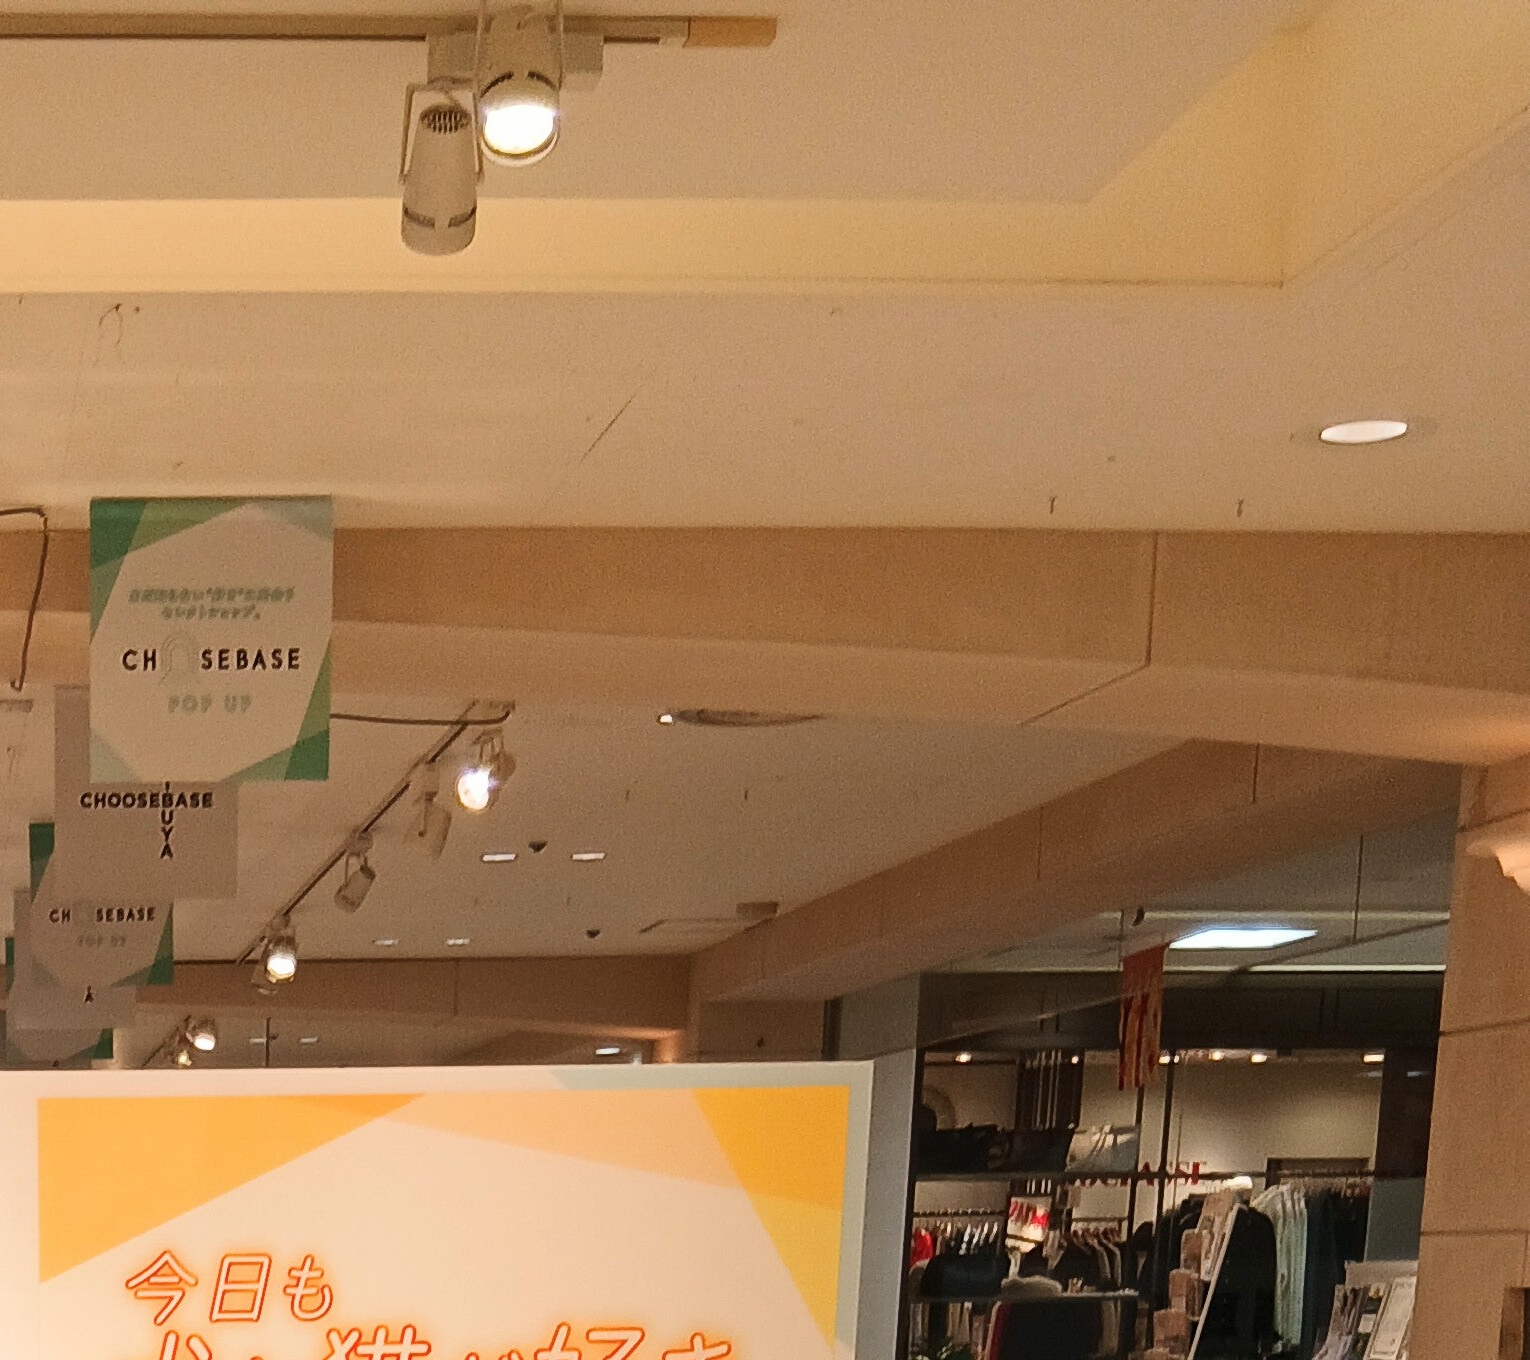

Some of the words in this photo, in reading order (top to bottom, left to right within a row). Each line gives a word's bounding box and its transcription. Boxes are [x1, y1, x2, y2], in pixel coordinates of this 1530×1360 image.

[79, 792, 214, 809] CHOOSEBASE
[161, 780, 174, 859] IBUYA
[125, 1249, 335, 1327] 今日も
